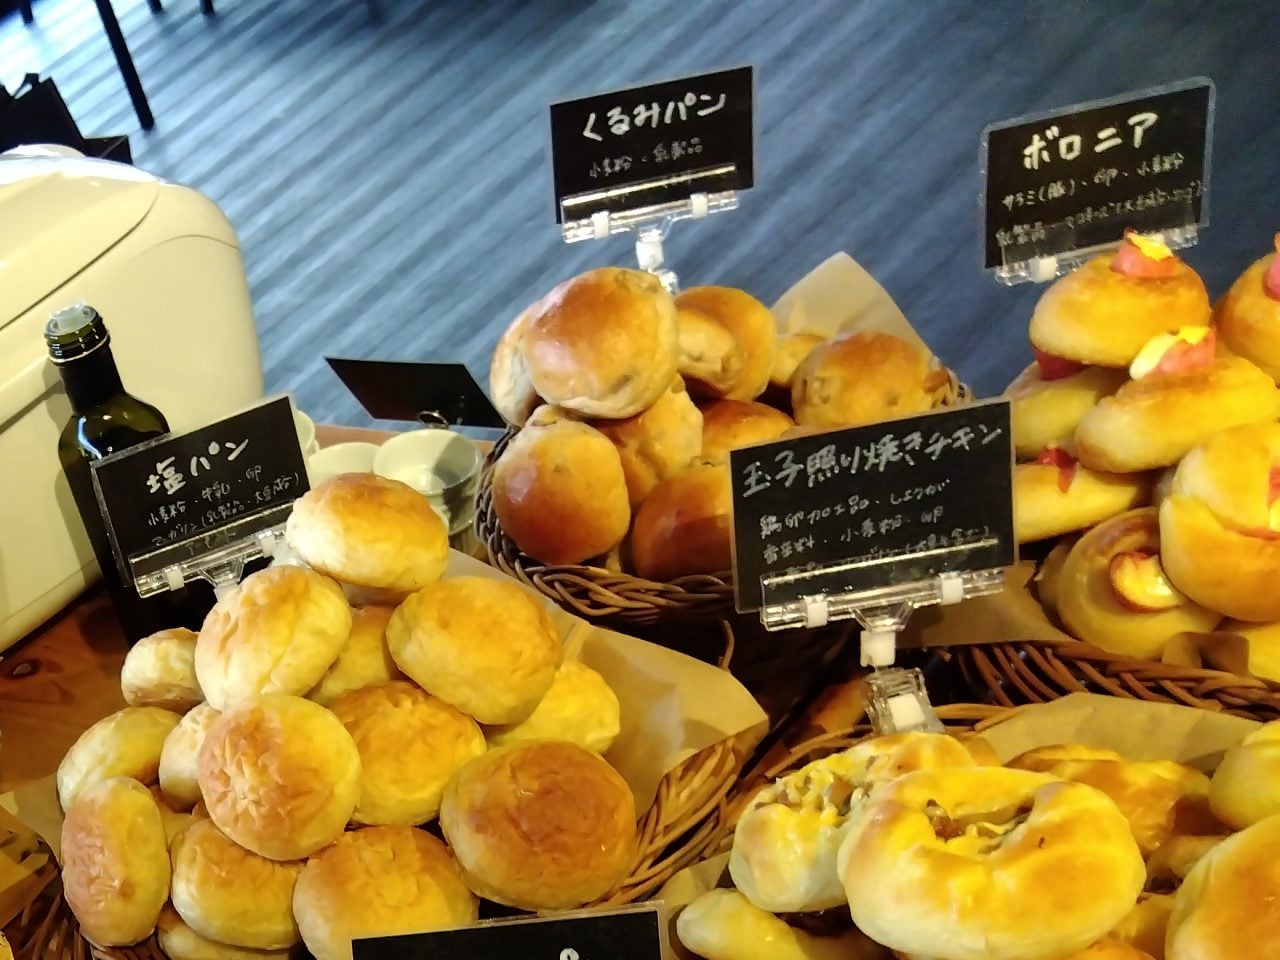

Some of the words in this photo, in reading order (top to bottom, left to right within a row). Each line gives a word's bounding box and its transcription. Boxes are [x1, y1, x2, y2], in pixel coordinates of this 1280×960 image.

[583, 92, 726, 141] くるみパン
[1023, 112, 1158, 170] ボロニア
[146, 439, 249, 495] 塩パン
[742, 424, 1002, 497] 玉子照り焼きチキン
